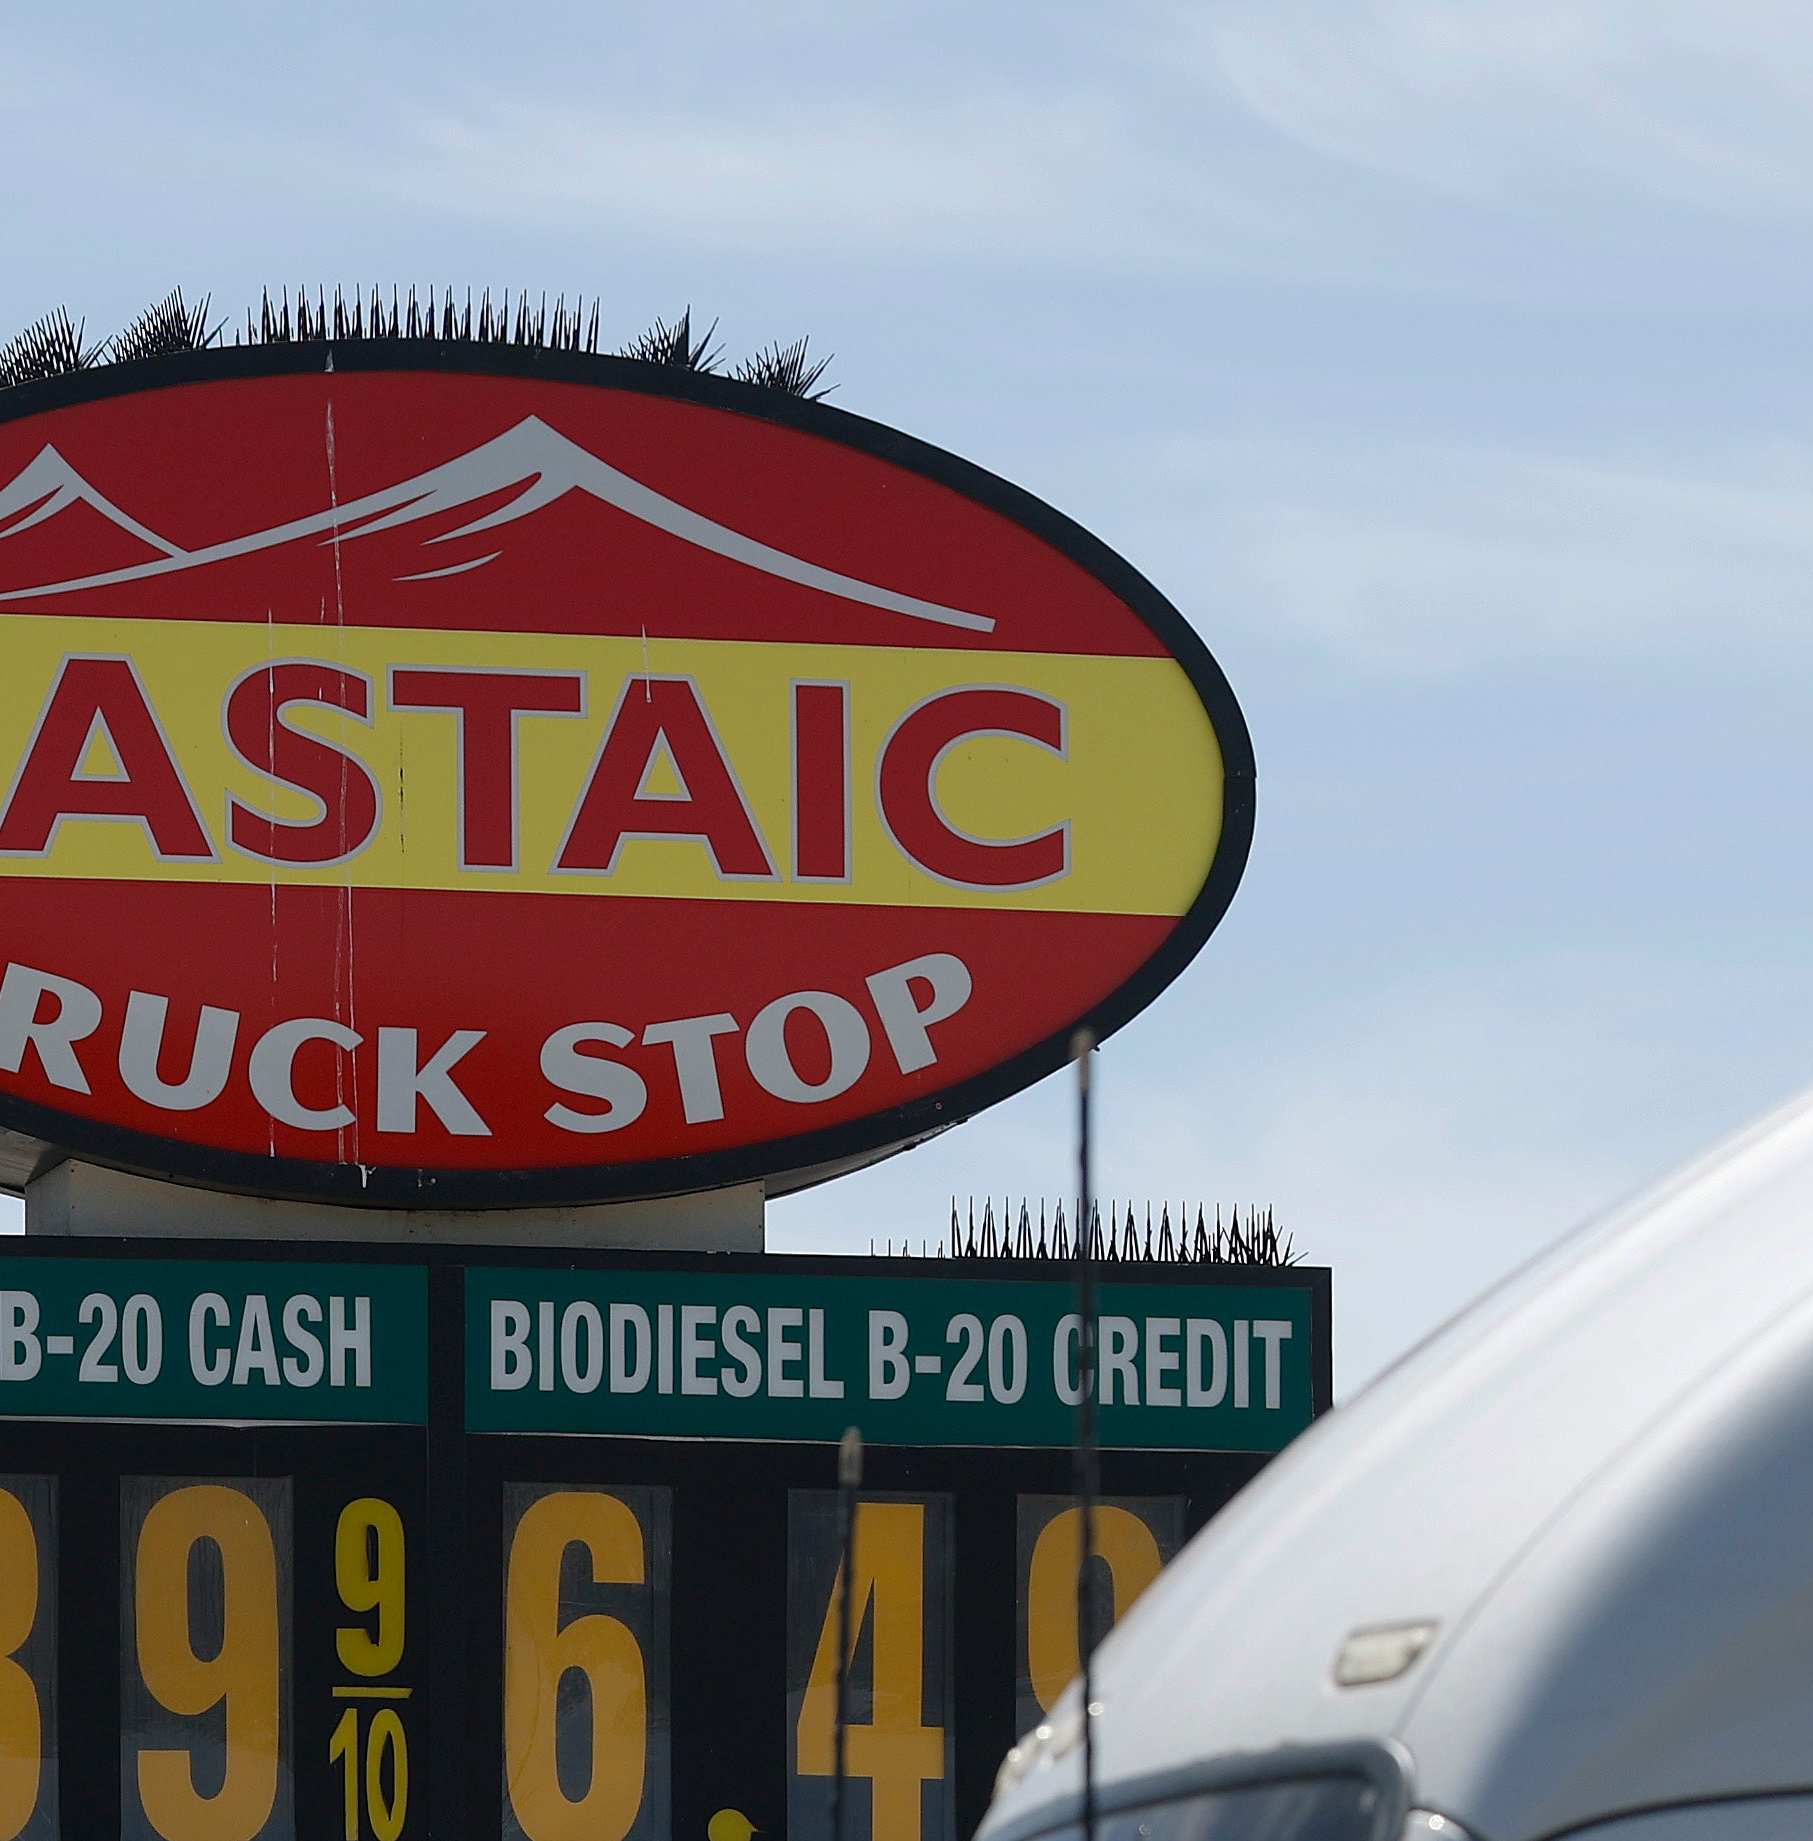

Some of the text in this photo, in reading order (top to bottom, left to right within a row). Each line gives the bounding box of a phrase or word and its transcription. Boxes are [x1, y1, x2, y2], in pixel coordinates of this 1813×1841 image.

[541, 952, 977, 1135] STOP
[188, 1291, 373, 1388] CASH
[489, 1299, 1293, 1410] BIODIESEL B-20 CREDIT
